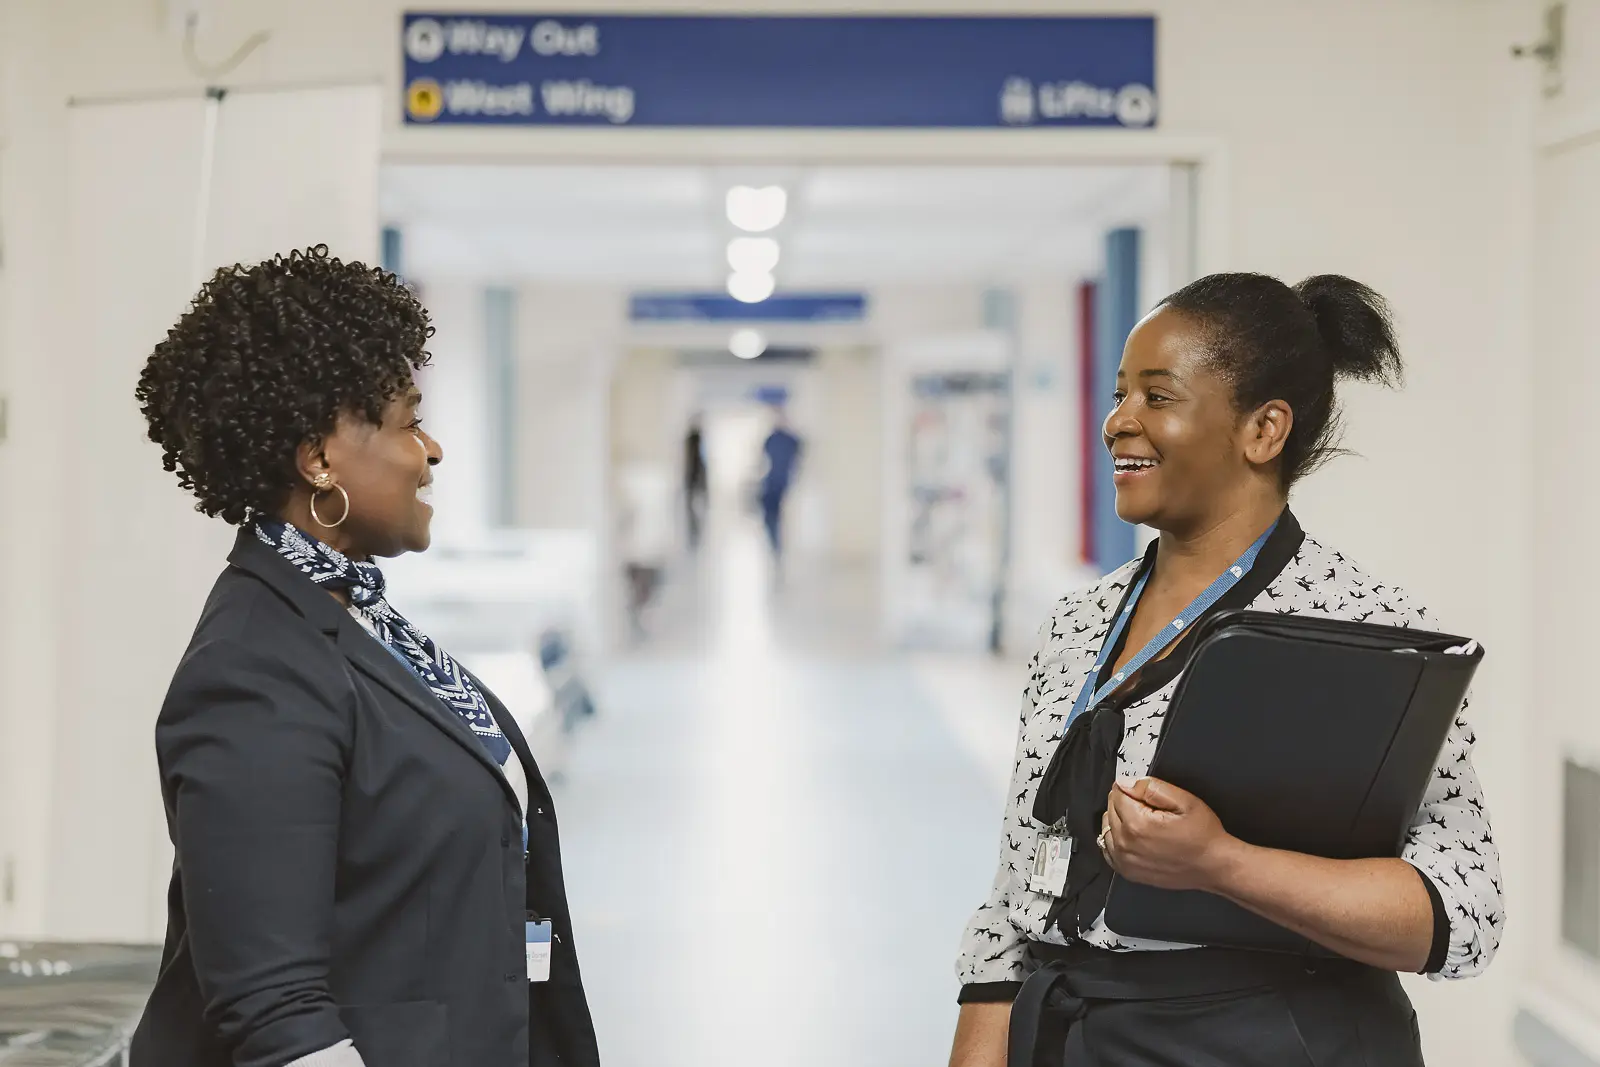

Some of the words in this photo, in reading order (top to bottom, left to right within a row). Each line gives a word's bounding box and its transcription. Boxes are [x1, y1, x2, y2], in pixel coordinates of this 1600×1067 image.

[446, 20, 525, 62] Way
[530, 19, 599, 56] Out
[446, 79, 533, 116] West
[541, 78, 635, 123] Wing
[1038, 80, 1115, 118] Lifts
